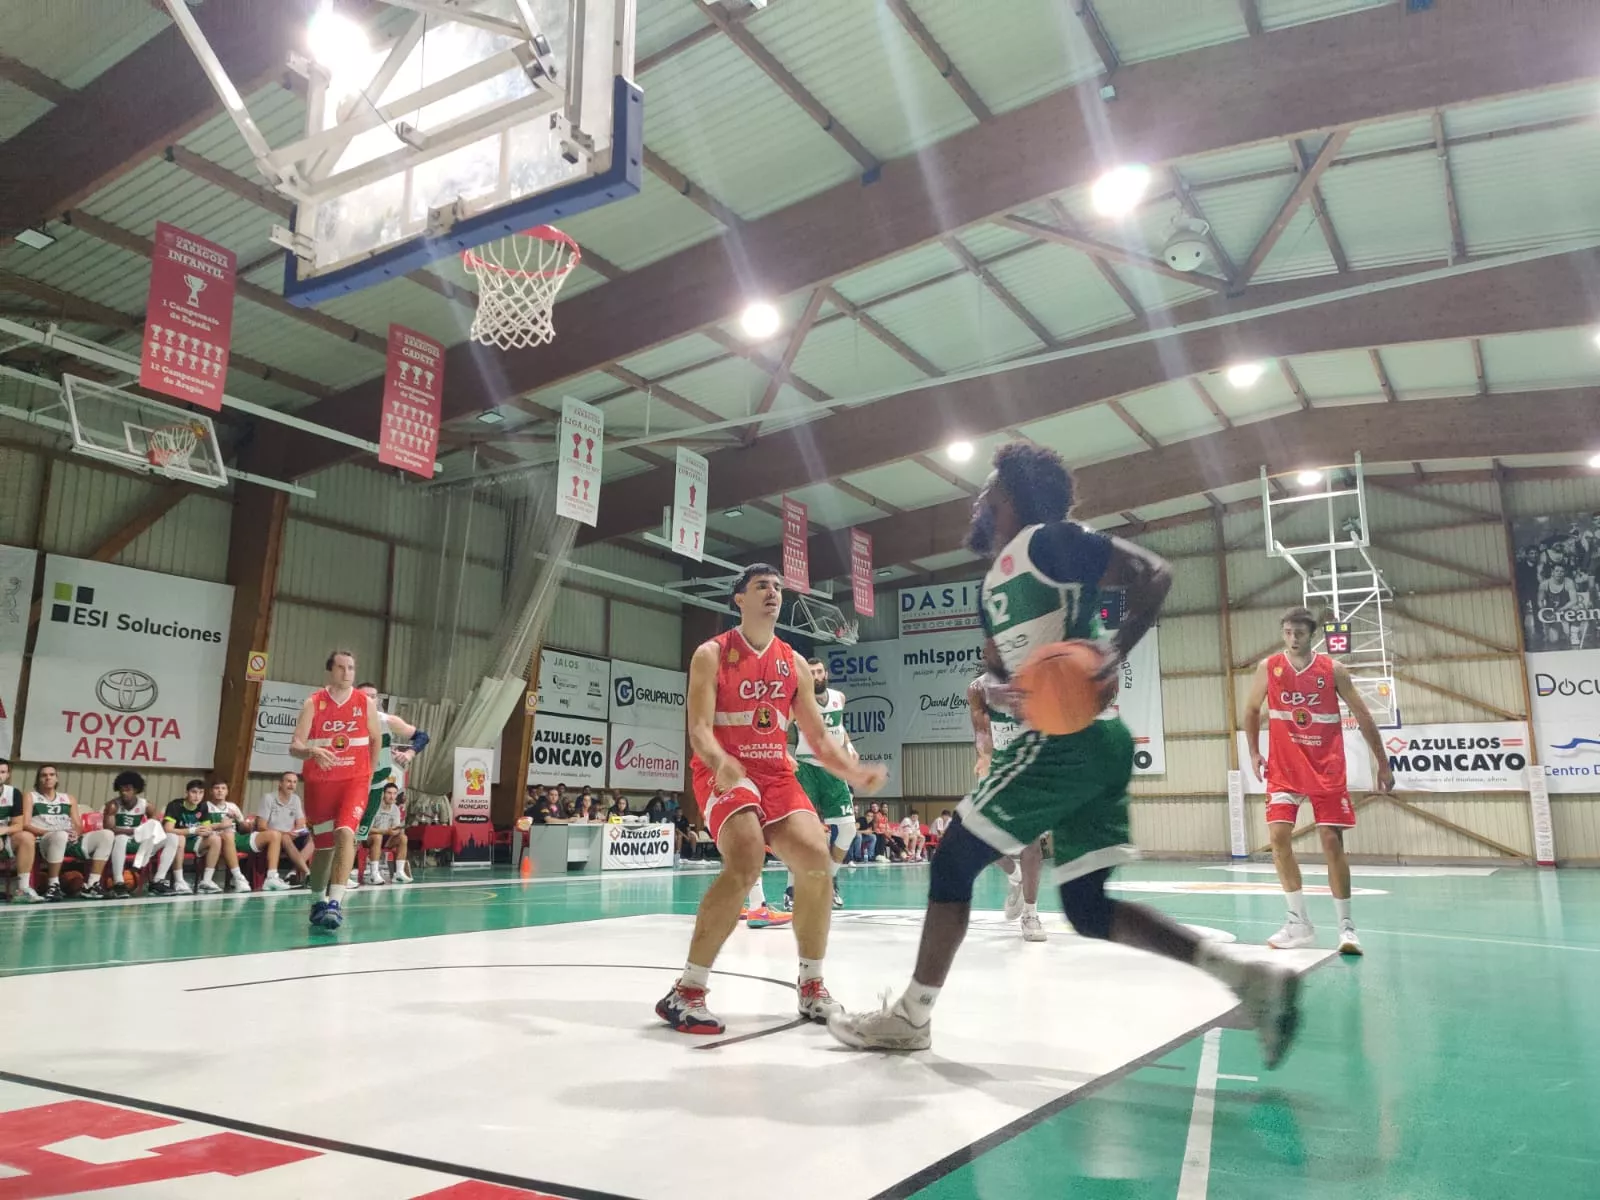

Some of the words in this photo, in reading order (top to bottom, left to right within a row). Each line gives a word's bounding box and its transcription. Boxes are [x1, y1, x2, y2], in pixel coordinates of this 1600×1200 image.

[902, 586, 980, 612] DASI
[73, 607, 108, 628] ESI
[117, 613, 222, 643] Soluciones
[1329, 636, 1347, 650] 52
[904, 646, 982, 666] mhlsport
[776, 659, 790, 677] 13
[739, 679, 787, 700] CBZ
[1316, 677, 1326, 689] 5
[635, 688, 686, 706] GRUPAUTO
[920, 694, 949, 711] David
[949, 693, 970, 710] Lloy
[1280, 691, 1321, 706] CBZ
[62, 710, 181, 740] TOYOTA
[322, 720, 359, 732] CBZ
[534, 730, 591, 746] AZULEJOS
[1408, 737, 1501, 751] AZULEJOS
[71, 736, 167, 762] ARTAL
[1388, 753, 1526, 772] MONCAYO
[840, 804, 853, 816] 14
[620, 829, 661, 839] AZULEJOS
[610, 841, 669, 856] MONCAYO
